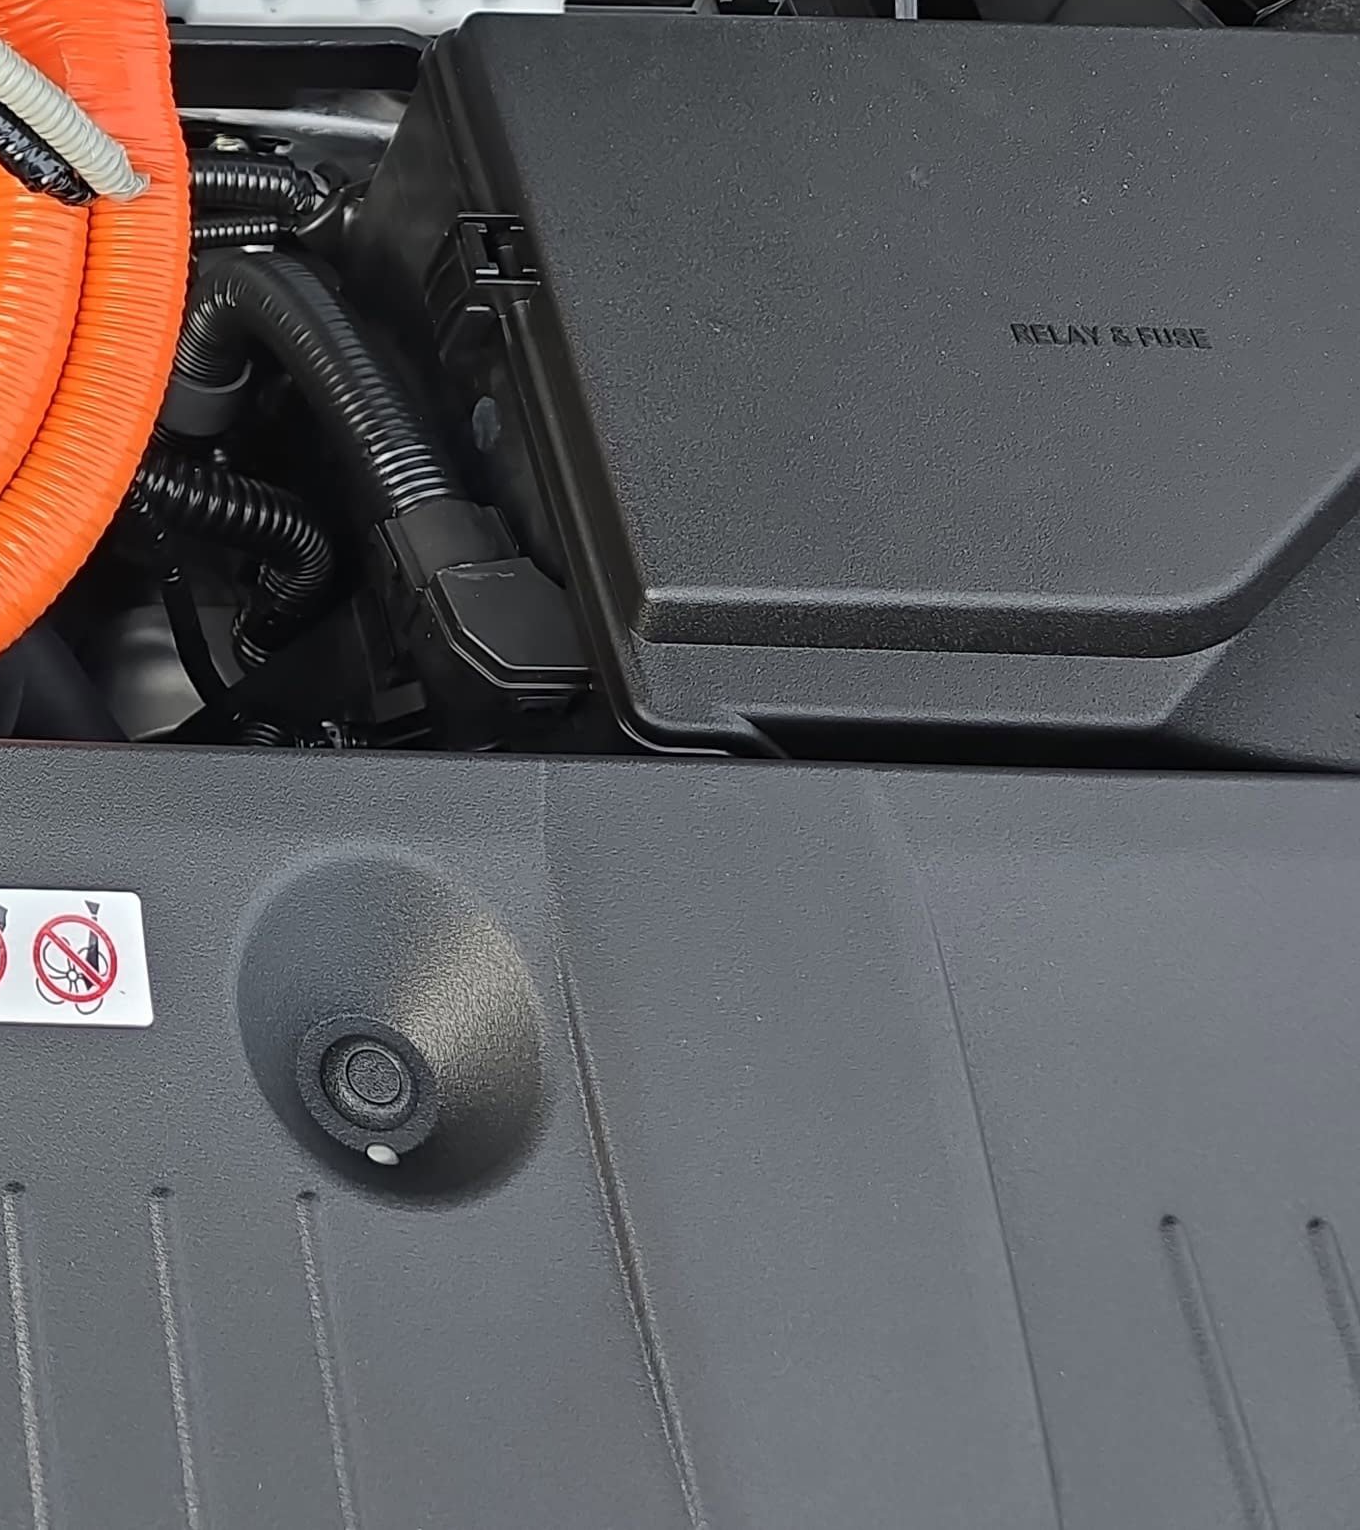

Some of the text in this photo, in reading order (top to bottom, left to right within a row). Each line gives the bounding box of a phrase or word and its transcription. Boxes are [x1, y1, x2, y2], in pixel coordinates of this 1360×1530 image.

[1010, 323, 1212, 349] RELAY & FUSE
